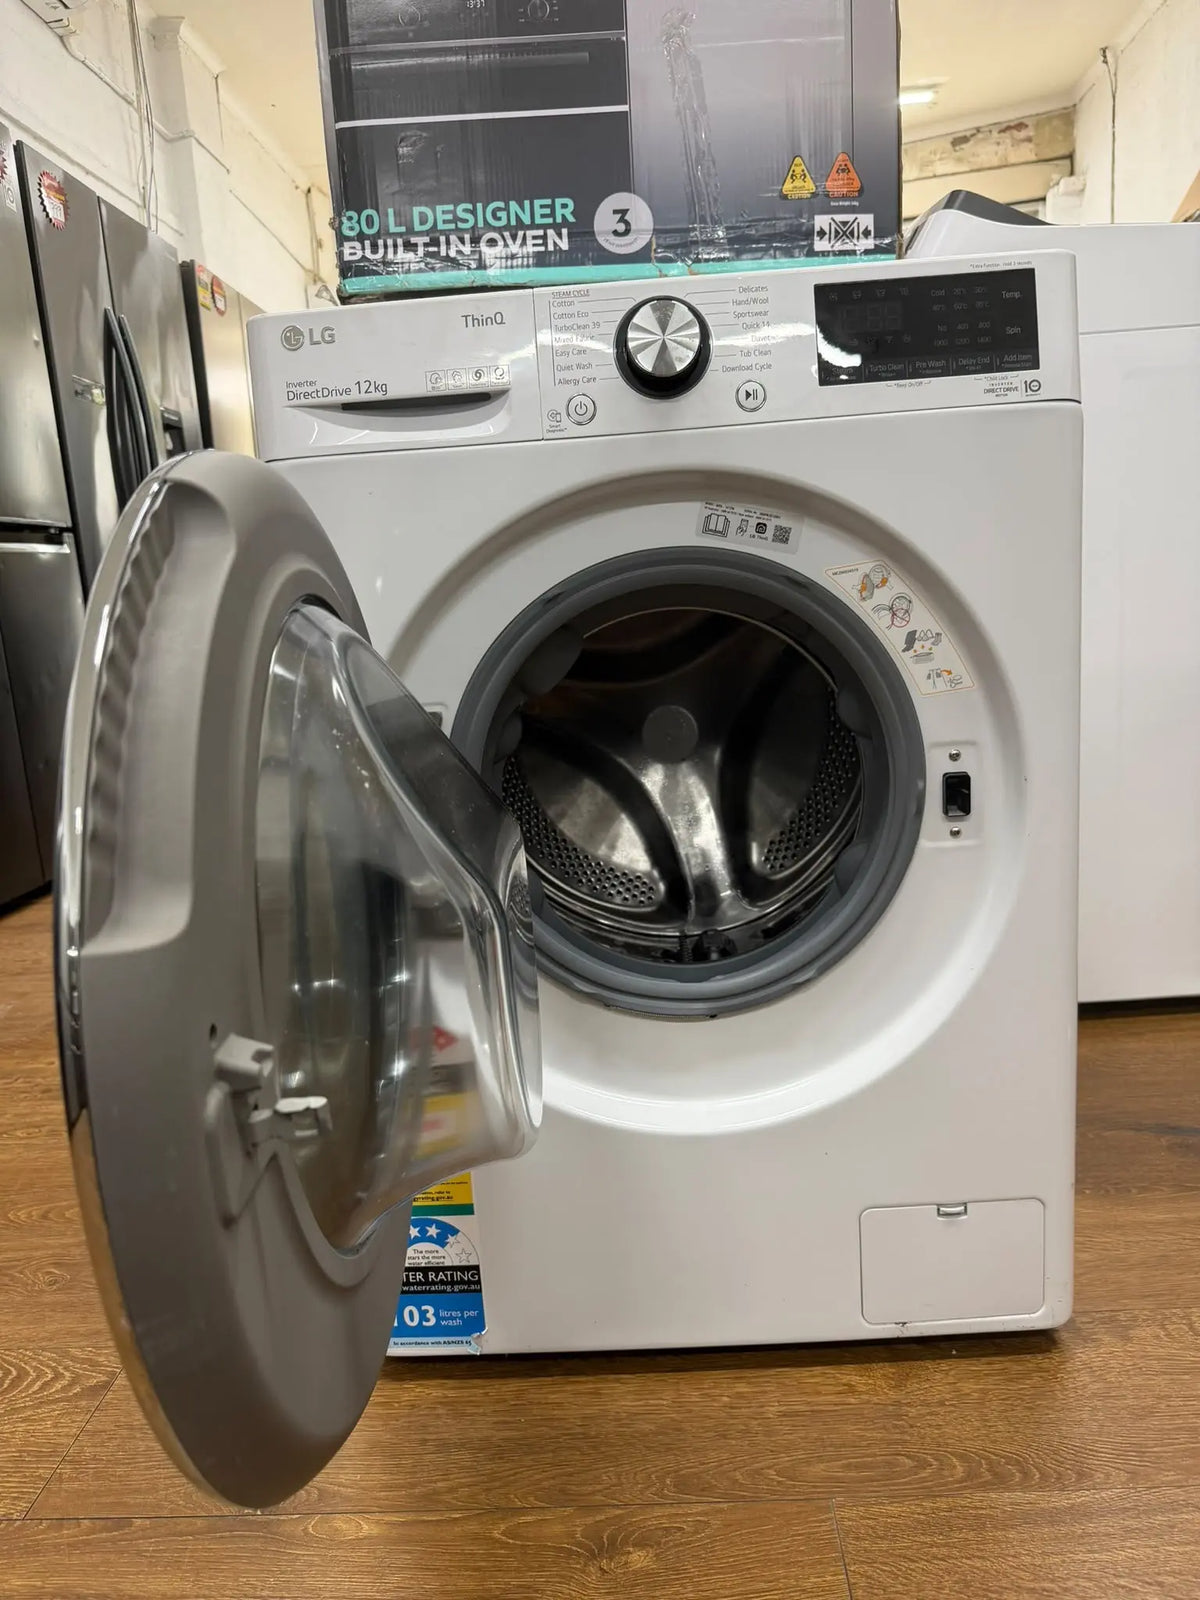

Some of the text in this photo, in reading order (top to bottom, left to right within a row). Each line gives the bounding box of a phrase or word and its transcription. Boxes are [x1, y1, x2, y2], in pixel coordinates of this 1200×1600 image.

[341, 198, 576, 236] 80 L DESIGNER
[611, 208, 632, 238] 3
[343, 228, 569, 261] BUILT-IN OVEN
[552, 289, 590, 298] STEAM CYCLE
[738, 285, 768, 294] Delicates
[1002, 291, 1023, 300] Temp.
[731, 297, 769, 306] Hand/Wool
[733, 310, 769, 319] Sportswear
[461, 311, 506, 329] ThinQ
[554, 321, 601, 331] TurboClean 39
[742, 322, 760, 331] Quick
[1006, 326, 1021, 335] Spin
[309, 326, 336, 346] LG
[554, 336, 576, 344] Mixed
[555, 348, 587, 358] Easy Care
[1003, 354, 1018, 362] Add
[556, 363, 574, 372] Quiet
[722, 362, 772, 373] Download Cycle
[927, 359, 946, 367] Wash
[286, 379, 317, 389] Inverter
[558, 376, 597, 386] Allergy Care
[354, 380, 388, 397] 12kg
[428, 1270, 479, 1282] RATING
[439, 1309, 461, 1317] litres
[463, 1309, 479, 1319] per
[440, 1318, 462, 1326] wash
